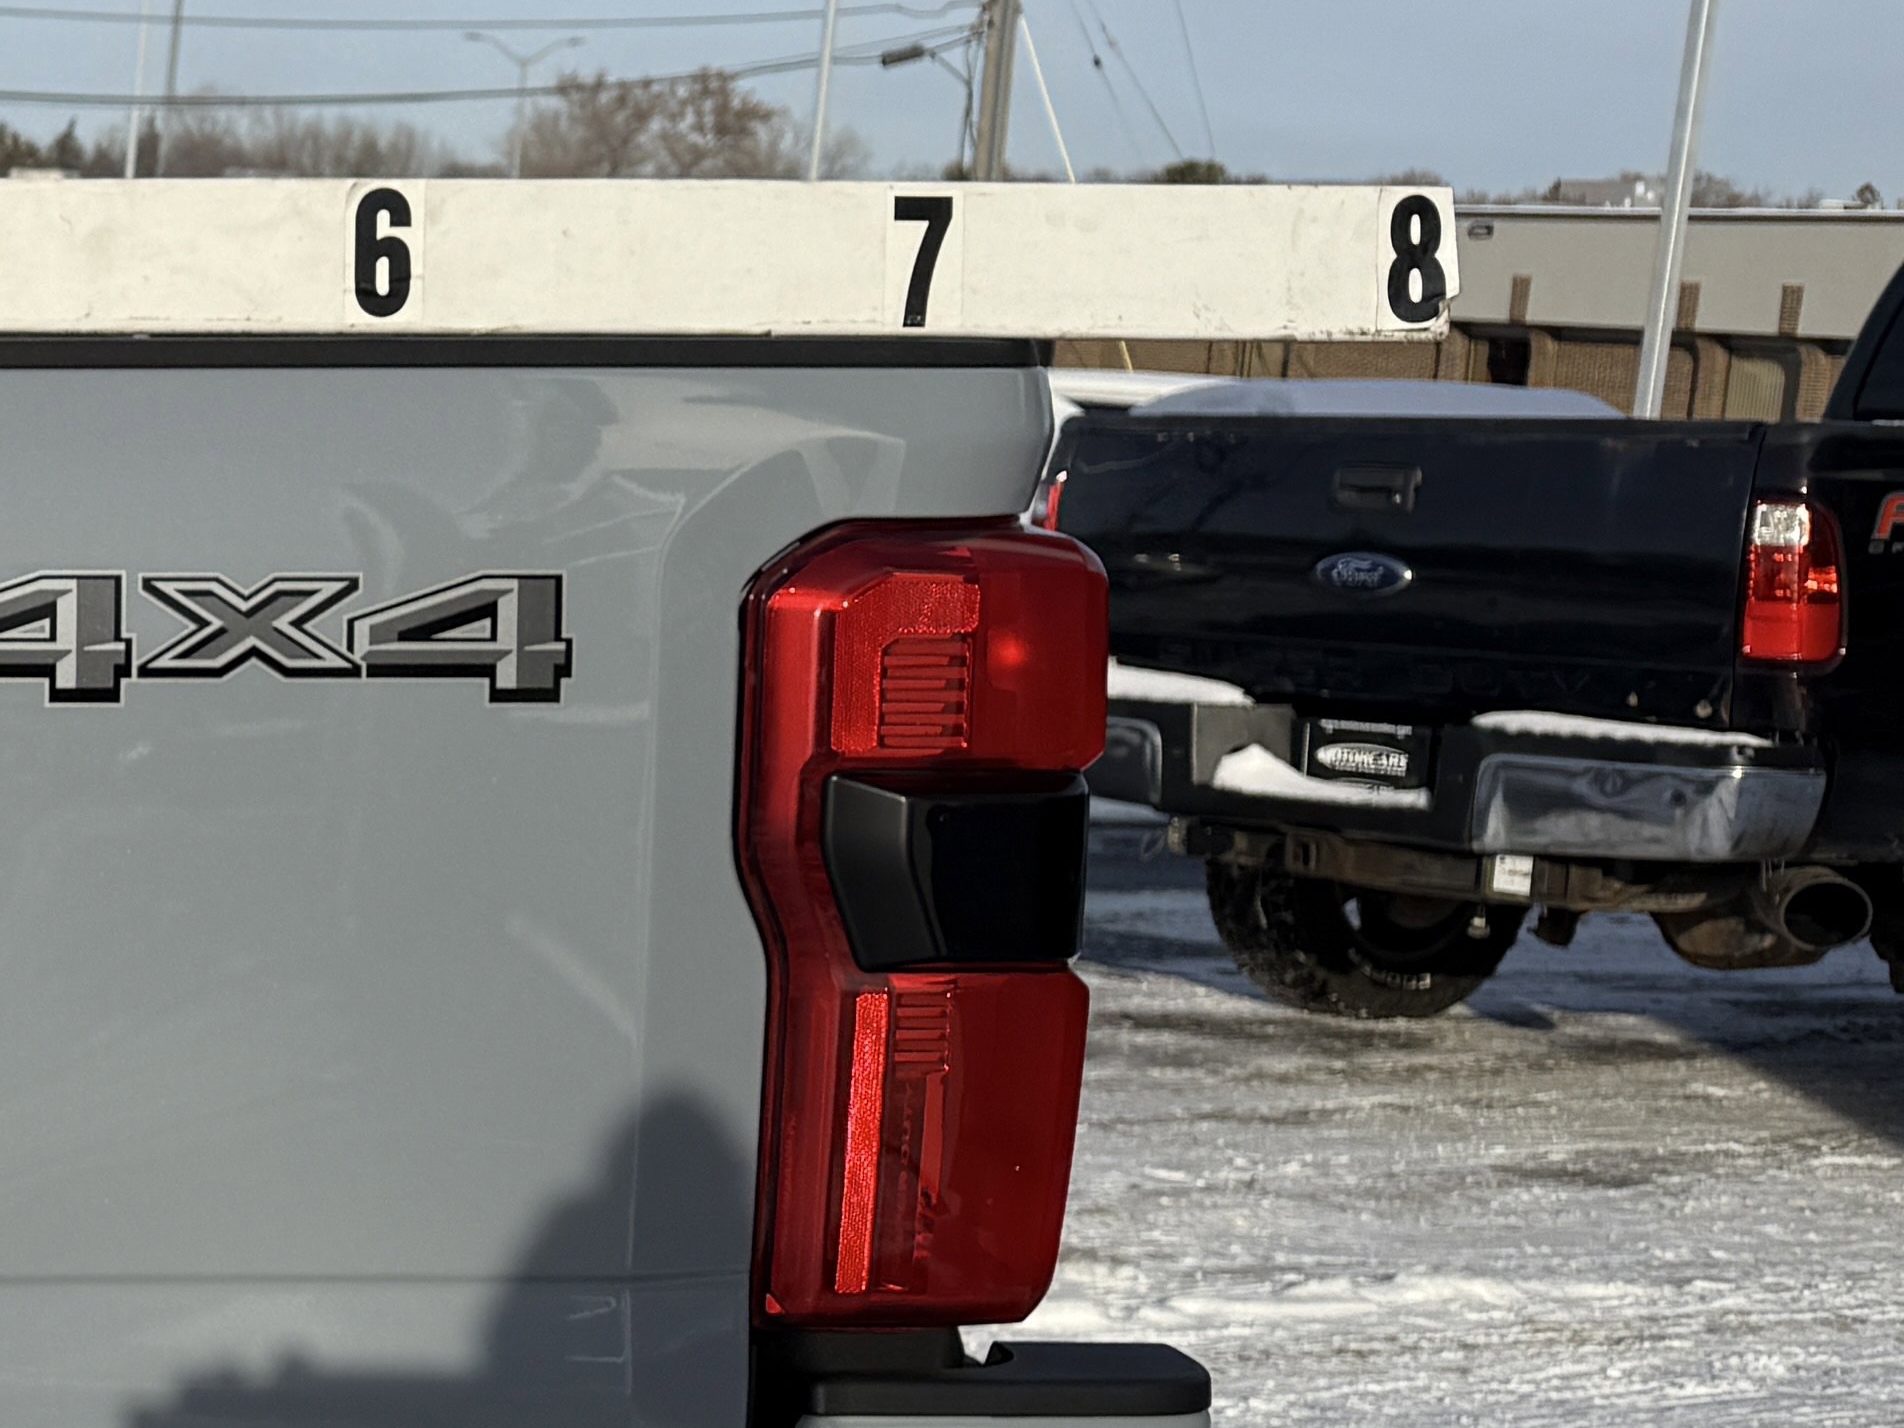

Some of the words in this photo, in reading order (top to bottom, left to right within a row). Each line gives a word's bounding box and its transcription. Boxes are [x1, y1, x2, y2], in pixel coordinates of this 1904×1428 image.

[354, 187, 413, 318] 6
[894, 196, 953, 328] 7
[1387, 194, 1447, 324] 8
